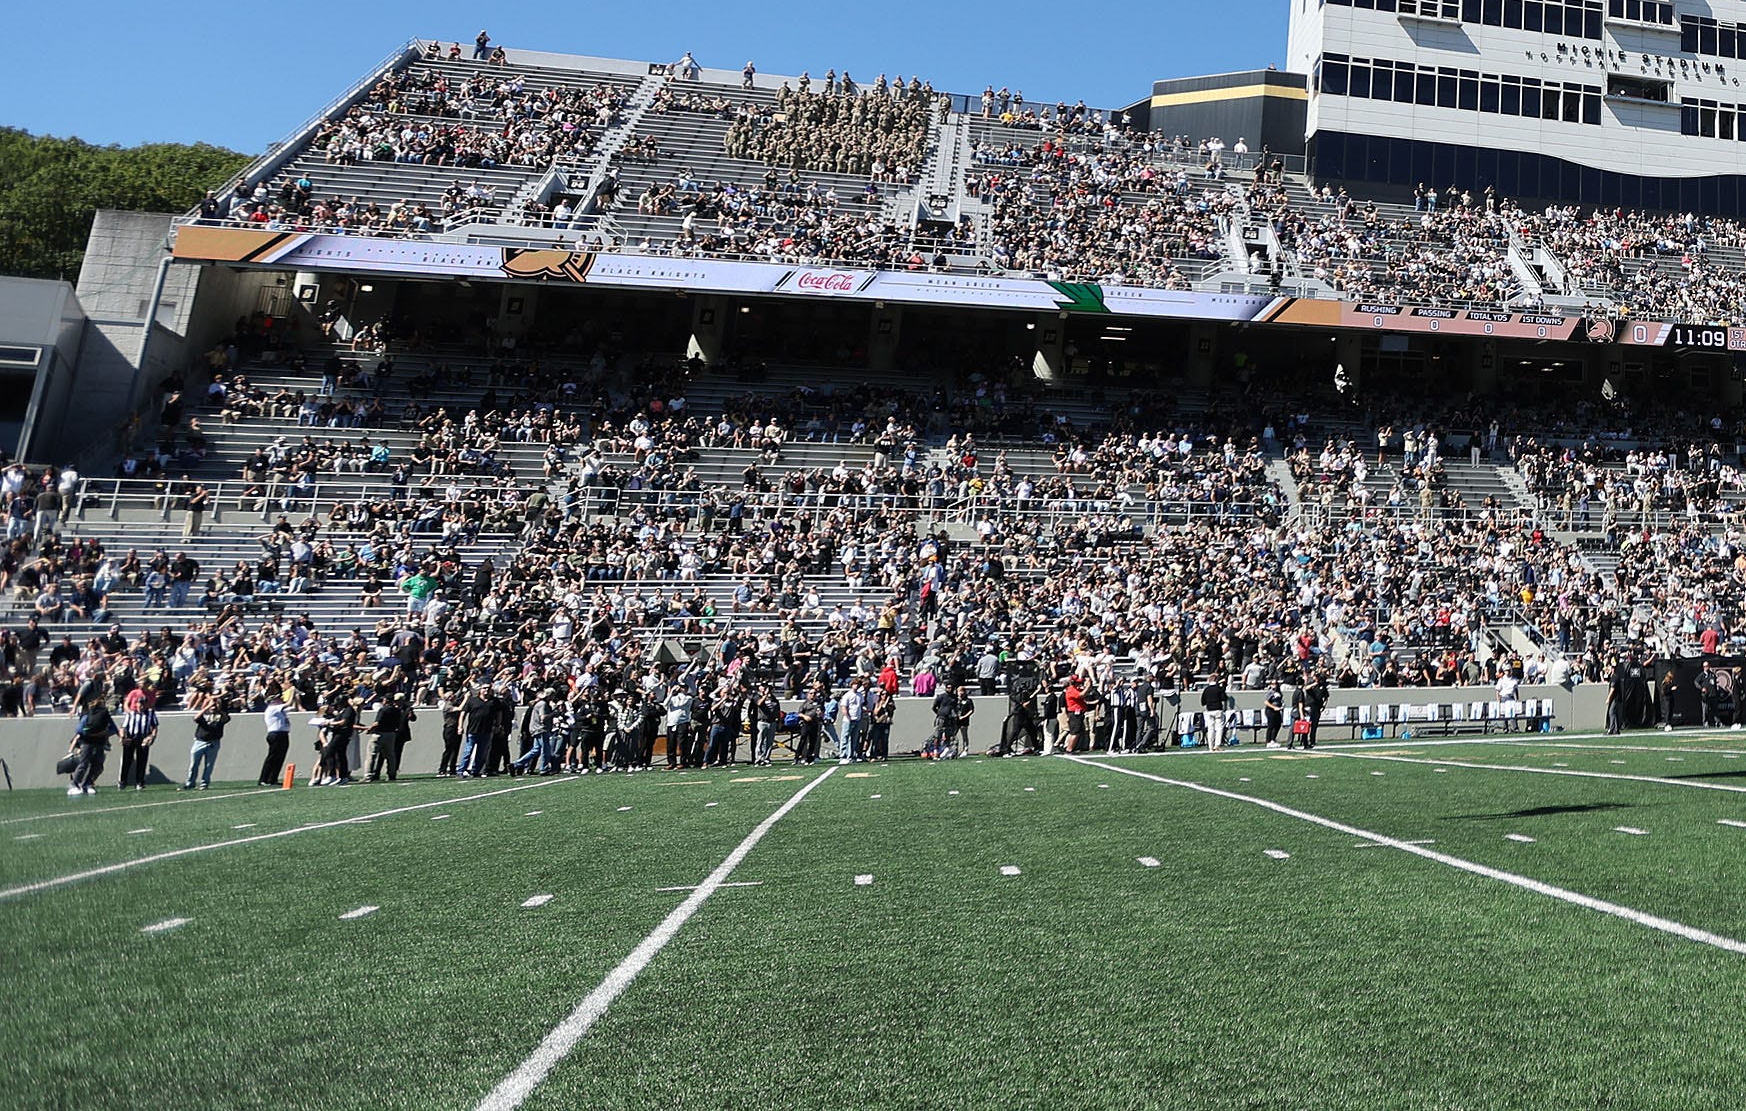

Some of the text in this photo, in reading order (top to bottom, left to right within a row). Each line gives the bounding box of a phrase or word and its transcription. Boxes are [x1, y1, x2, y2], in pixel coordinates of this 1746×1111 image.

[1557, 42, 1725, 75] MICHIE STADIUM
[601, 267, 706, 279] BLACK KNIGHTS
[1361, 305, 1397, 314] RUSHING
[1418, 309, 1451, 318] PASSING
[1373, 316, 1383, 327] 0
[1470, 312, 1508, 322] TOTAL YDS
[1522, 316, 1563, 326] 1ST DOWNS
[1430, 320, 1439, 331] 0
[1484, 323, 1493, 334] 0
[1537, 326, 1546, 337] 0
[1632, 325, 1648, 343] 0
[1730, 330, 1745, 340] 1ST
[1674, 328, 1725, 347] 11:09
